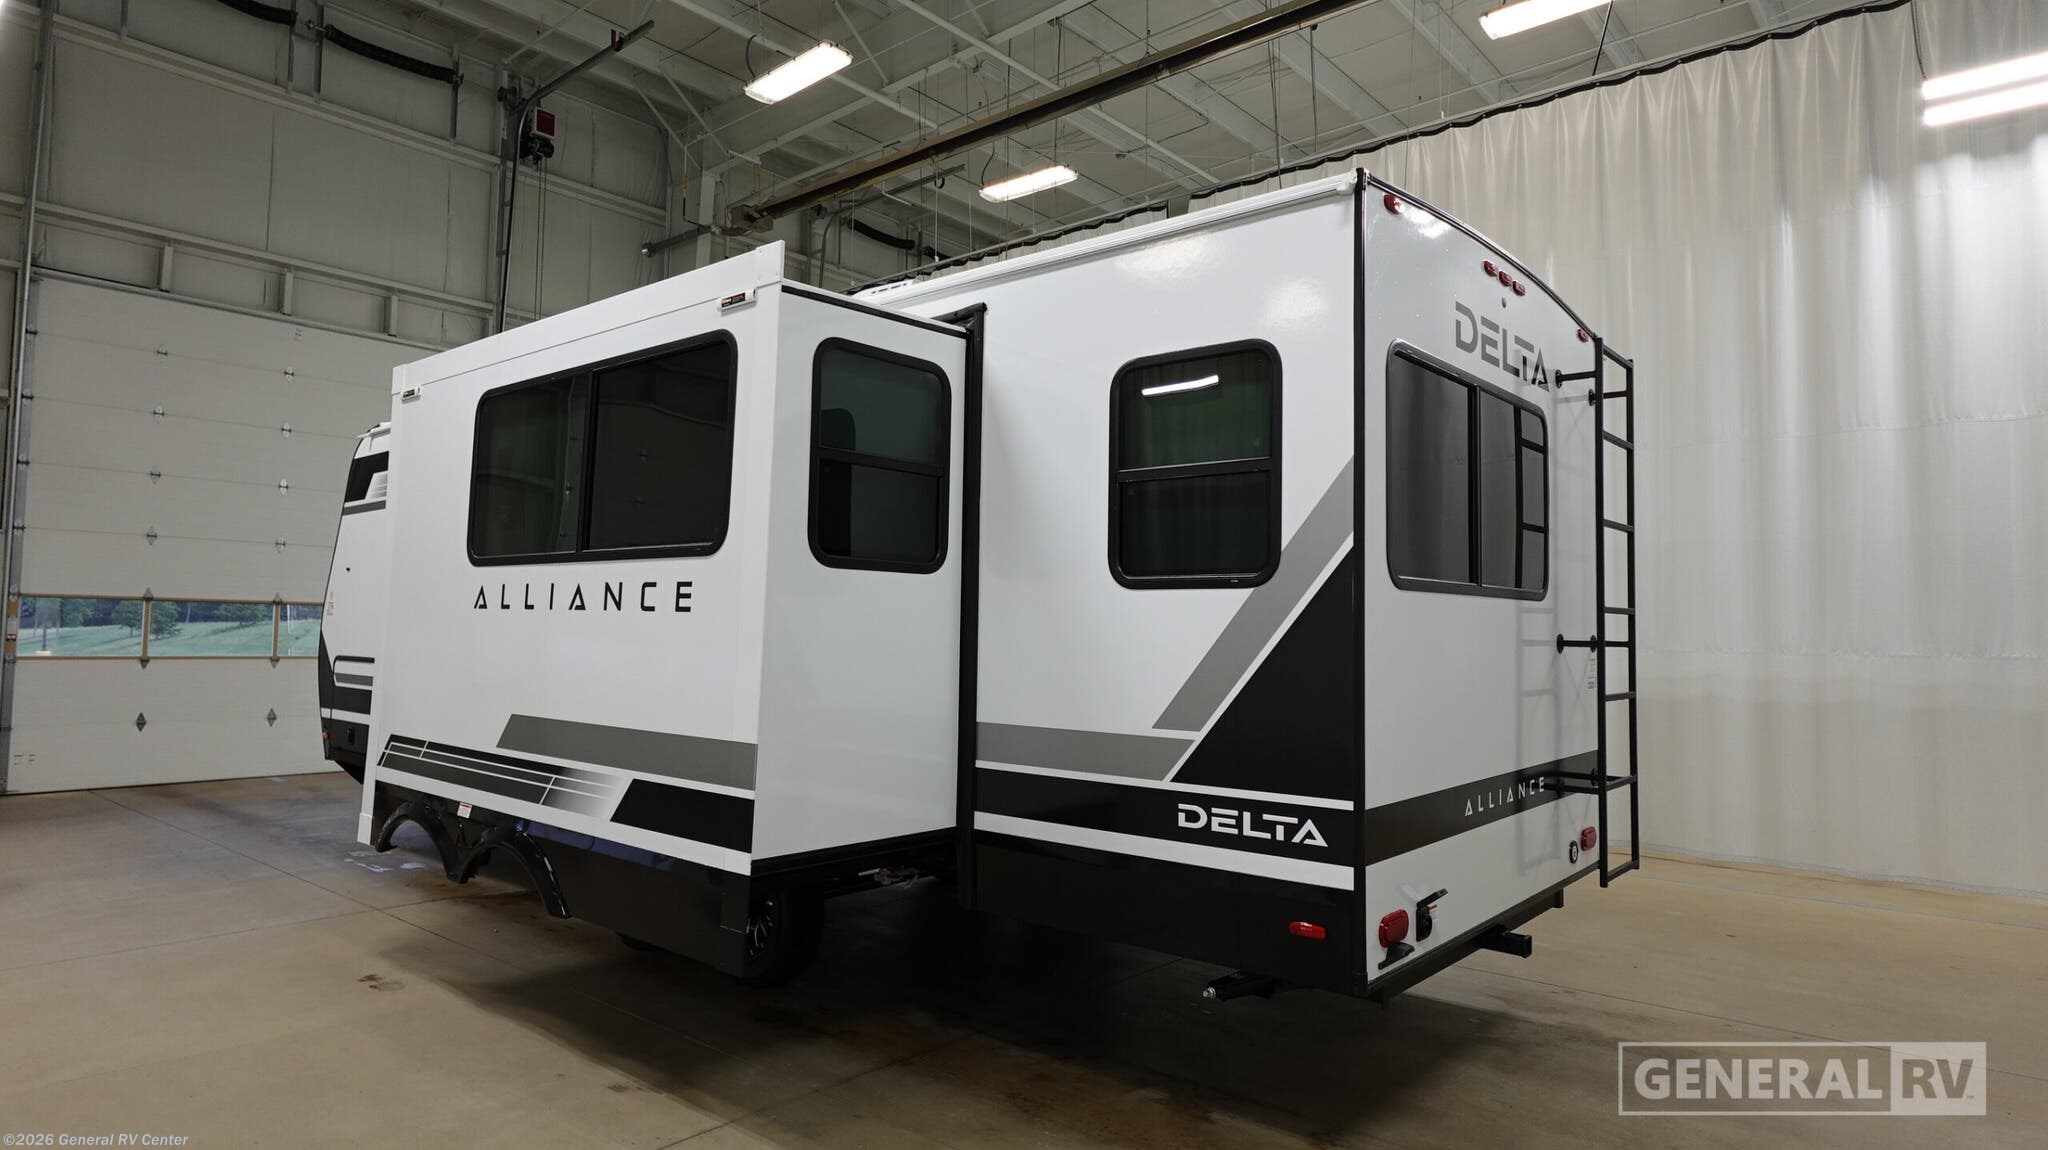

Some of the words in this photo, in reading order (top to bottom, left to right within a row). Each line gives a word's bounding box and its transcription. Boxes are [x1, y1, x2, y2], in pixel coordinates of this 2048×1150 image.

[1455, 301, 1550, 392] DELTA
[473, 581, 693, 612] ALLIANCE
[1464, 776, 1545, 817] ALLIANCE
[1177, 803, 1329, 848] DELTA
